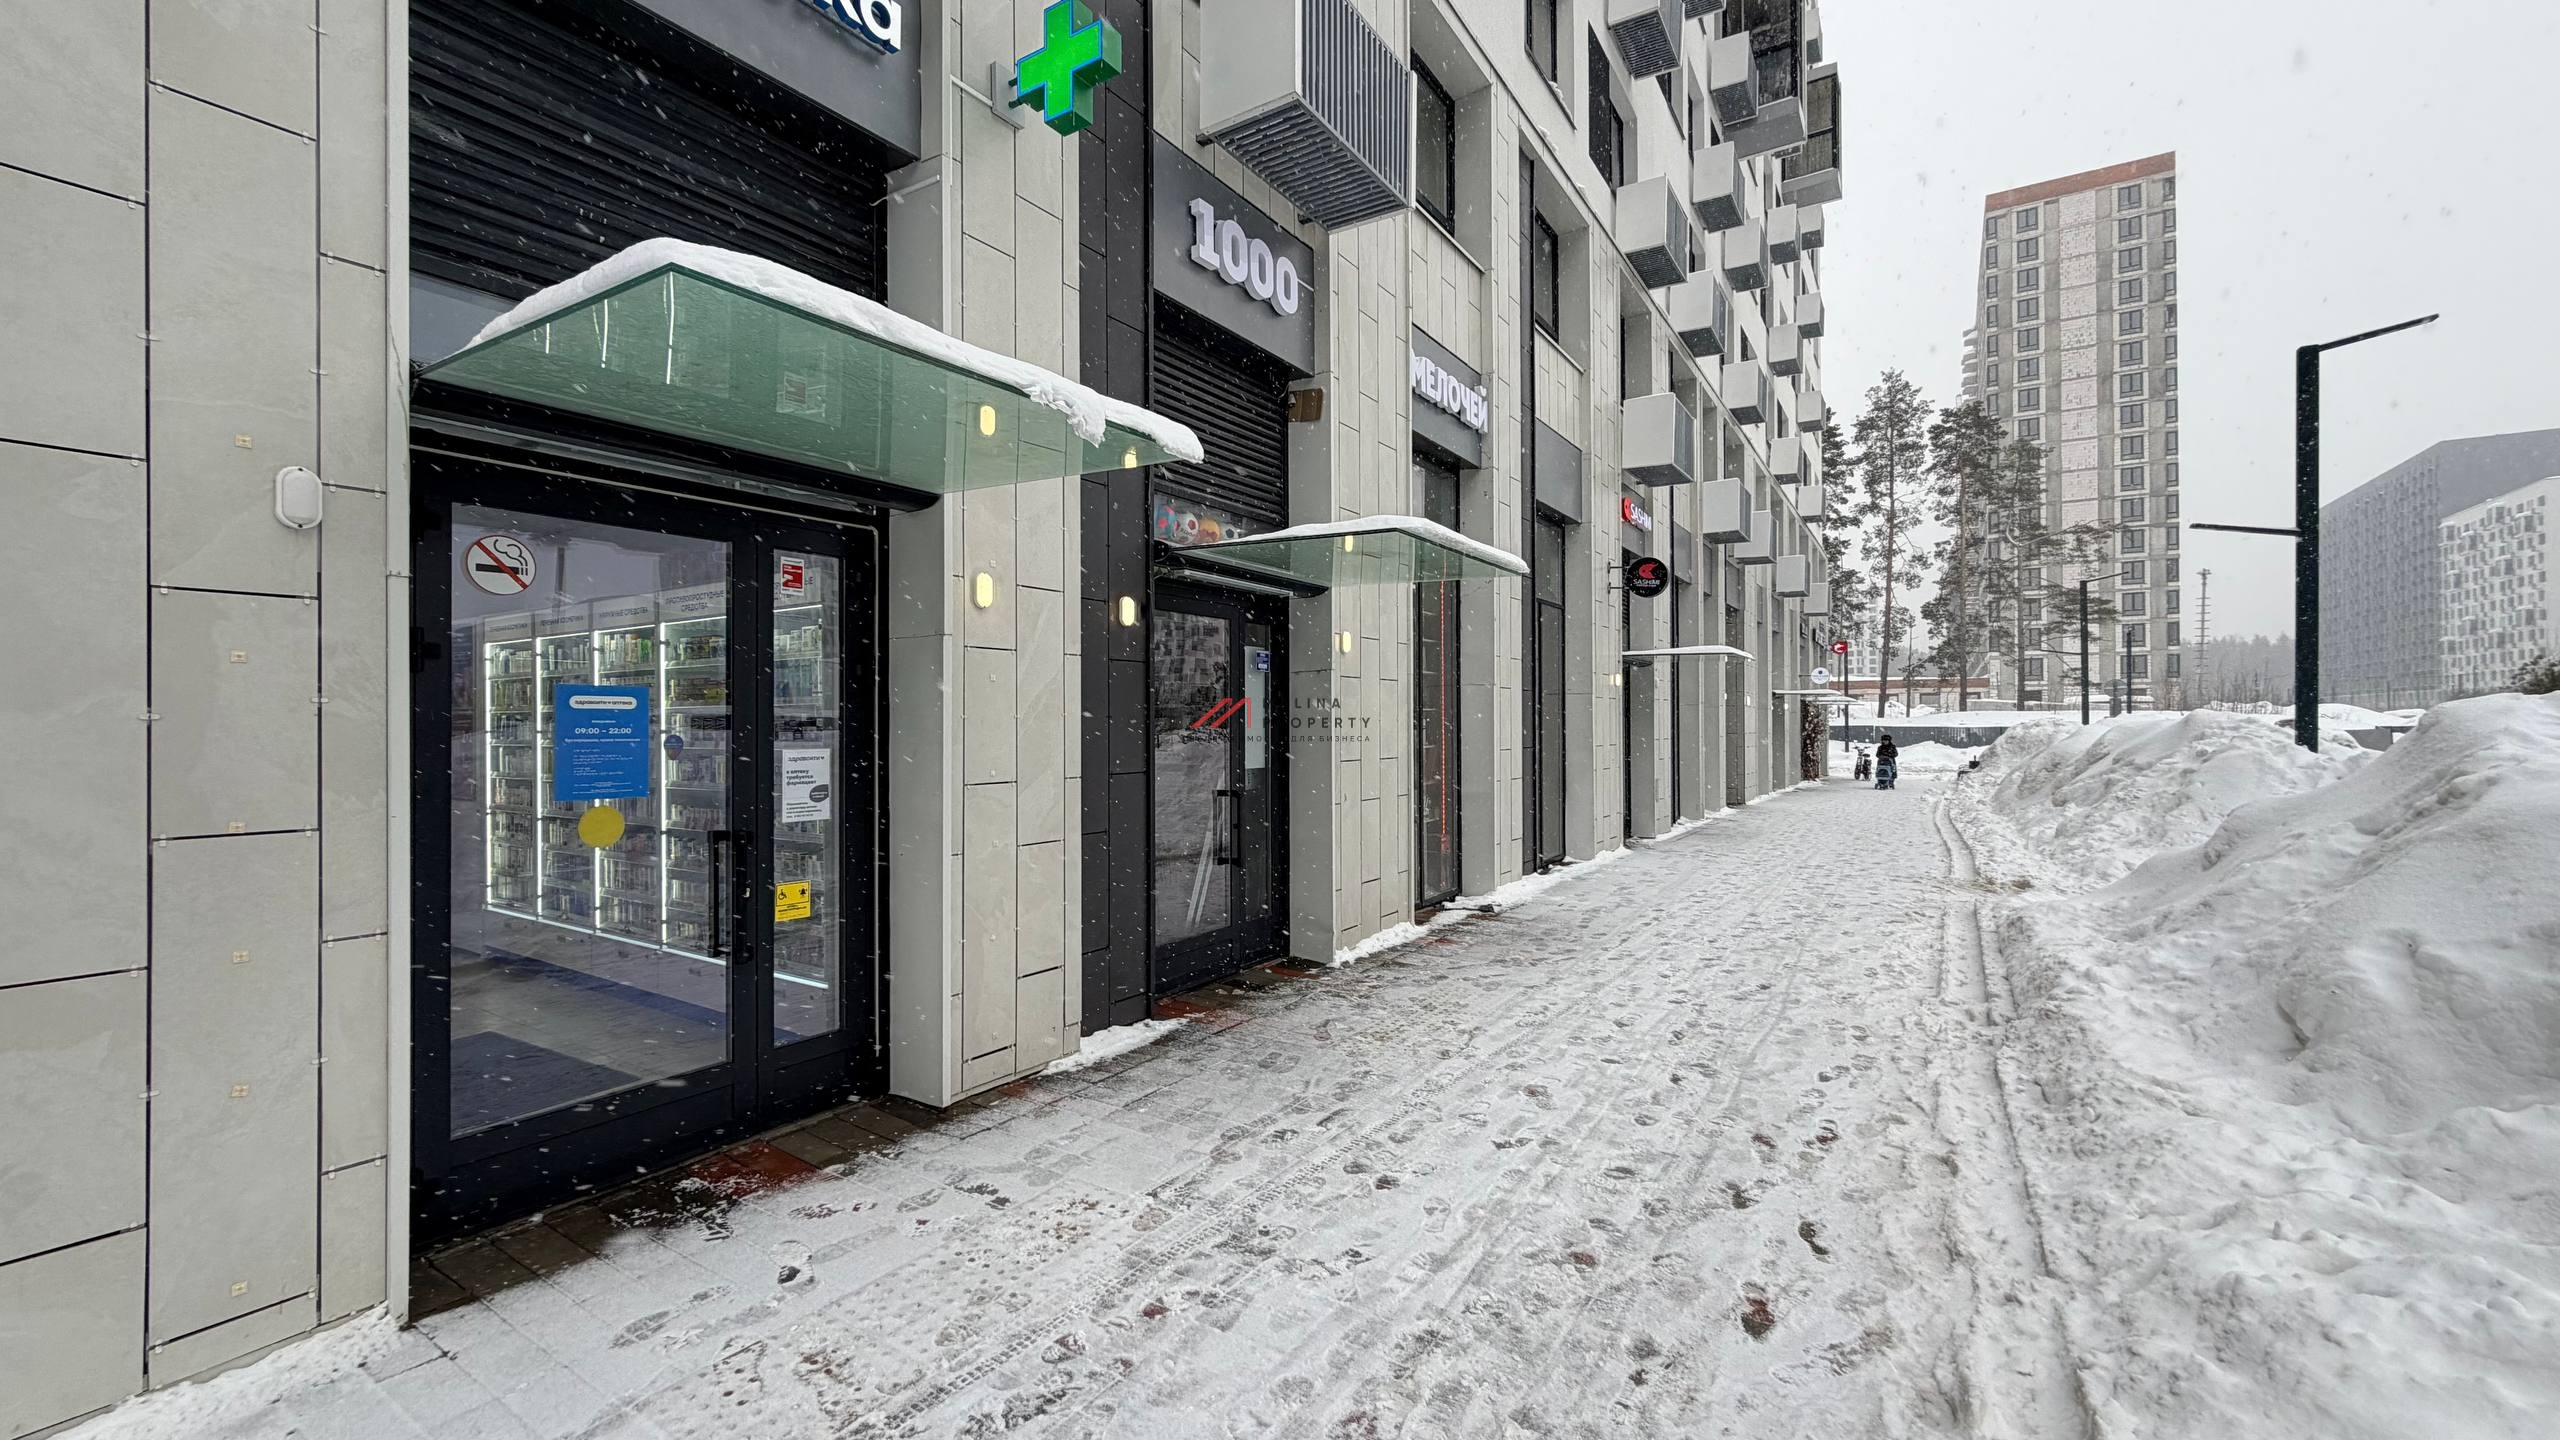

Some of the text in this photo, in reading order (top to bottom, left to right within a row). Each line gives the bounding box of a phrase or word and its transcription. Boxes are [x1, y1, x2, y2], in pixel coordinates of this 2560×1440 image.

[1189, 198, 1299, 315] 1000
[1411, 351, 1488, 433] МЕЛОЧЕЙ
[575, 727, 600, 736] 09:00
[609, 727, 632, 735] 22:00
